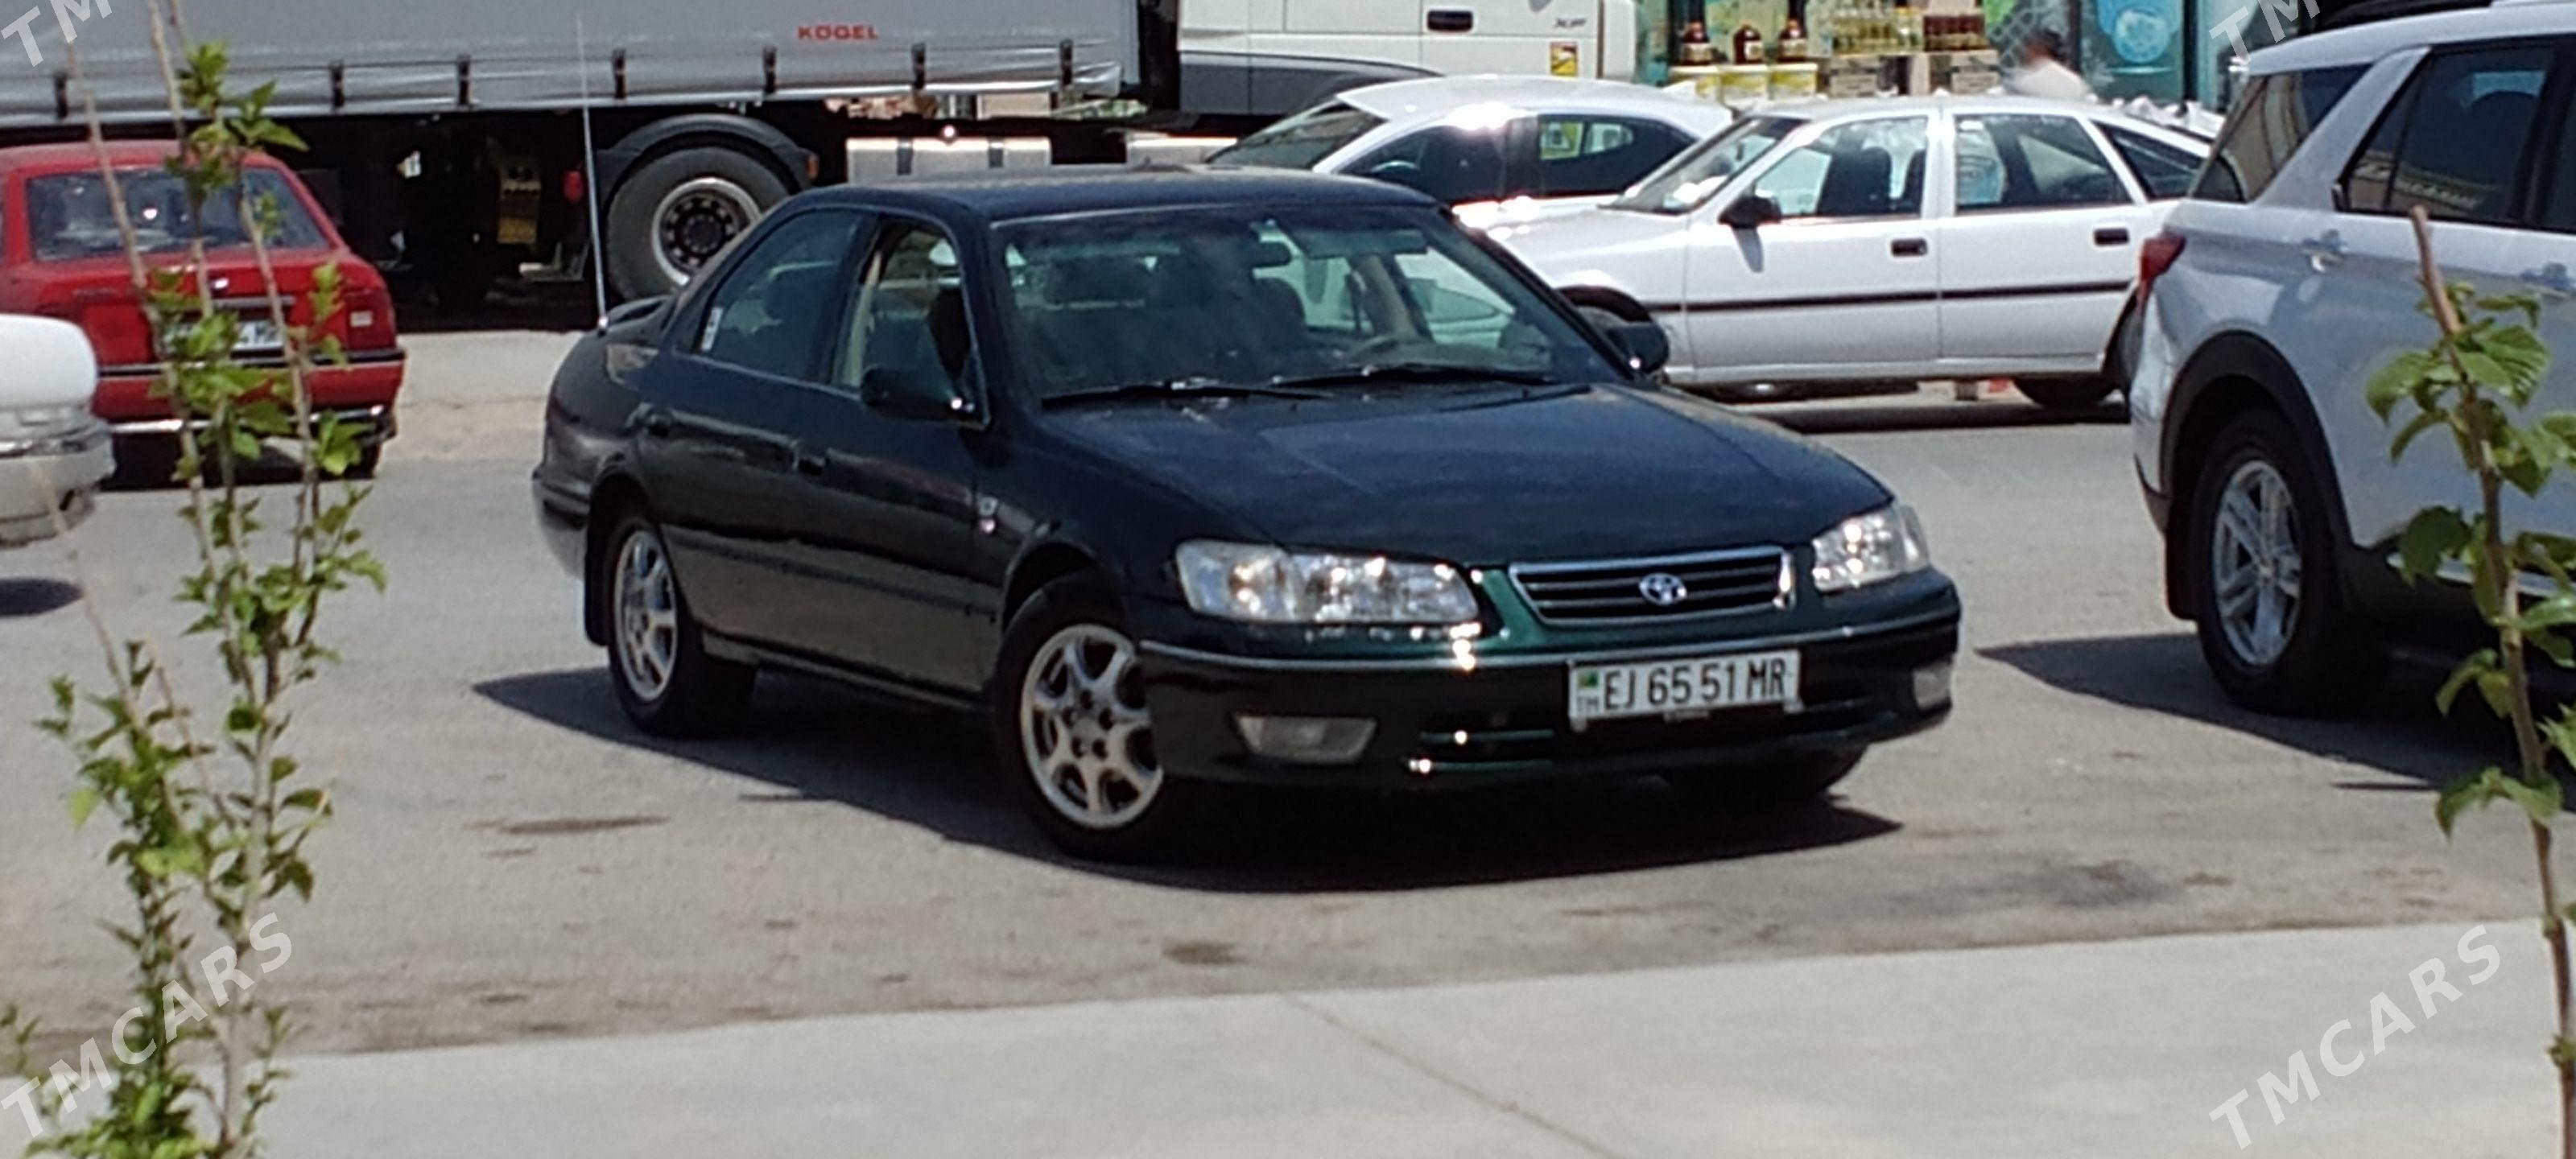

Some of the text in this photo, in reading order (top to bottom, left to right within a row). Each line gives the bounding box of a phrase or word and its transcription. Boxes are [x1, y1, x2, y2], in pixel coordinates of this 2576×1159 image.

[1604, 669, 1635, 710] EJ
[1649, 666, 1691, 705] 65
[1701, 662, 1736, 702] 51
[1746, 658, 1786, 699] MR
